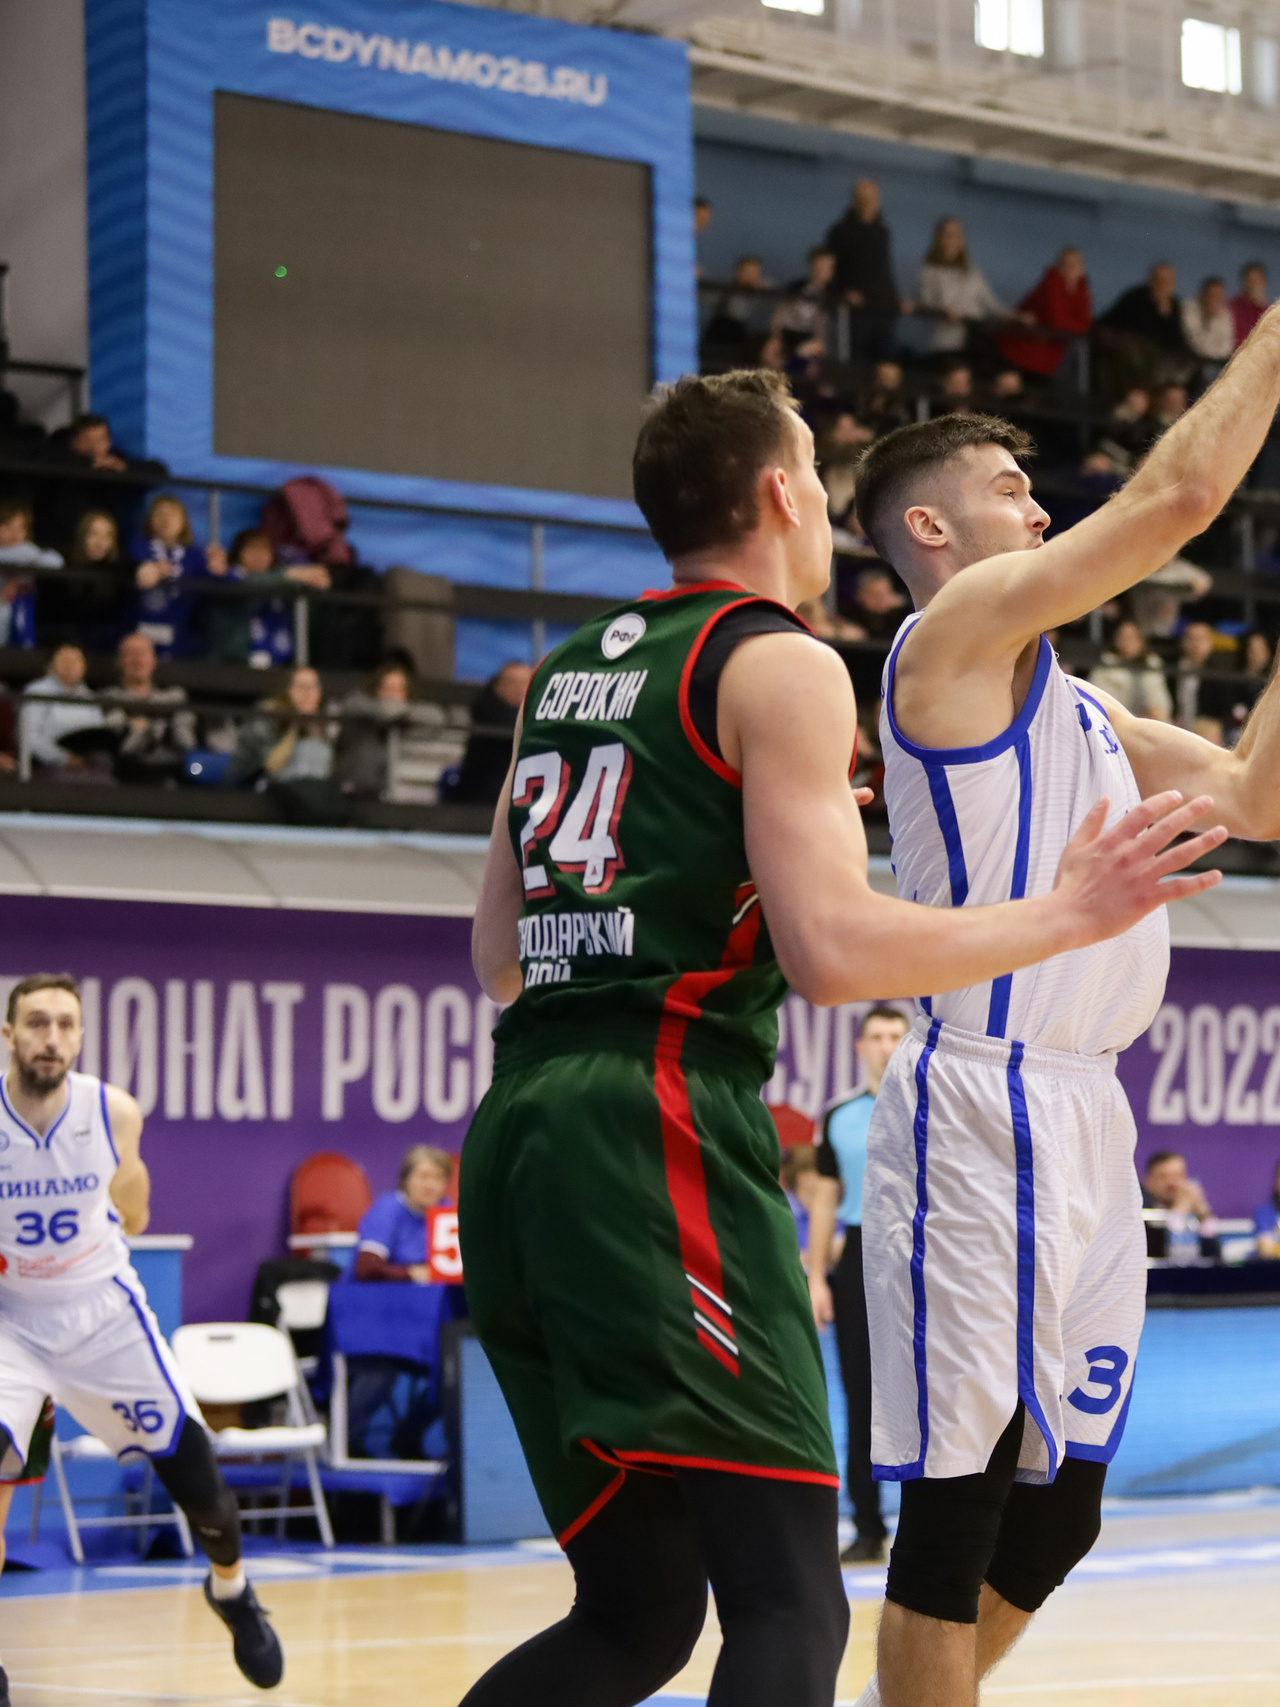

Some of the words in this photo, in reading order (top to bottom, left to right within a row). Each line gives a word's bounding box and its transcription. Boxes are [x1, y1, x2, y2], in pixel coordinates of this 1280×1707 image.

[535, 669, 649, 721] СОРОКИН
[512, 743, 633, 899] 24
[15, 1208, 79, 1246] 36
